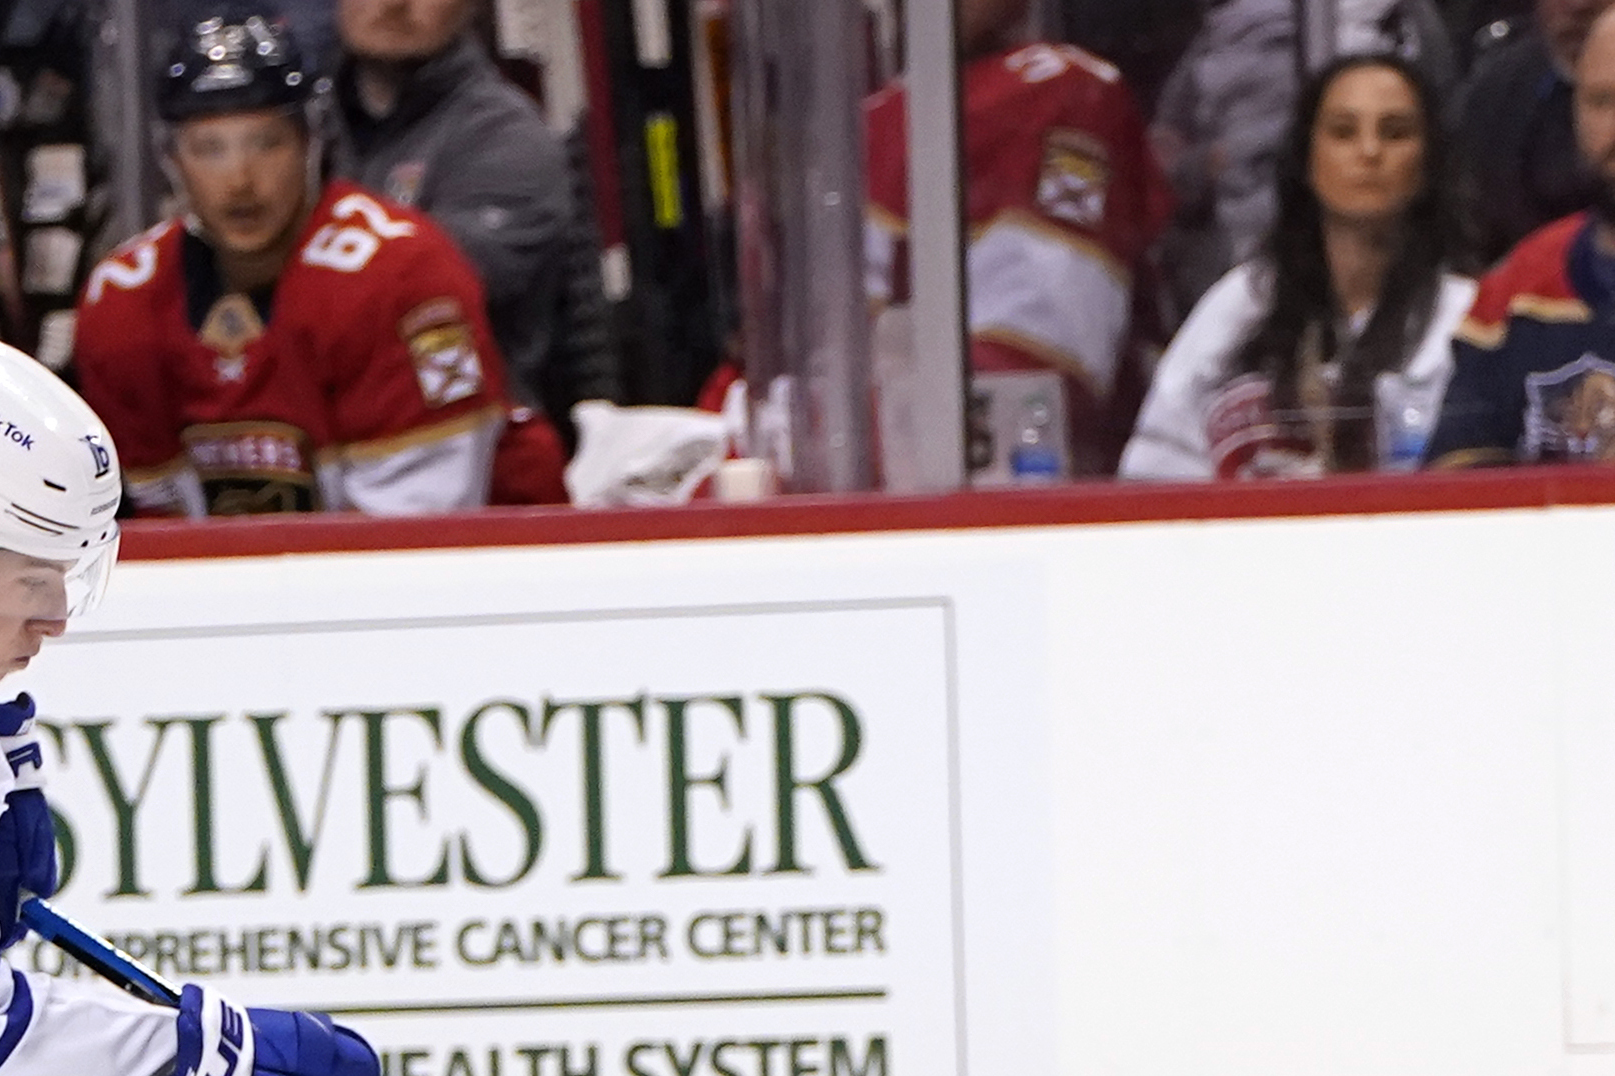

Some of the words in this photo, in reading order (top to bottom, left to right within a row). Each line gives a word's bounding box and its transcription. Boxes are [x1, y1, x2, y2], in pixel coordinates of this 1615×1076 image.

[3, 921, 438, 976] OPREHENSIVE
[457, 915, 668, 967] CANCER
[687, 907, 885, 959] CENTER
